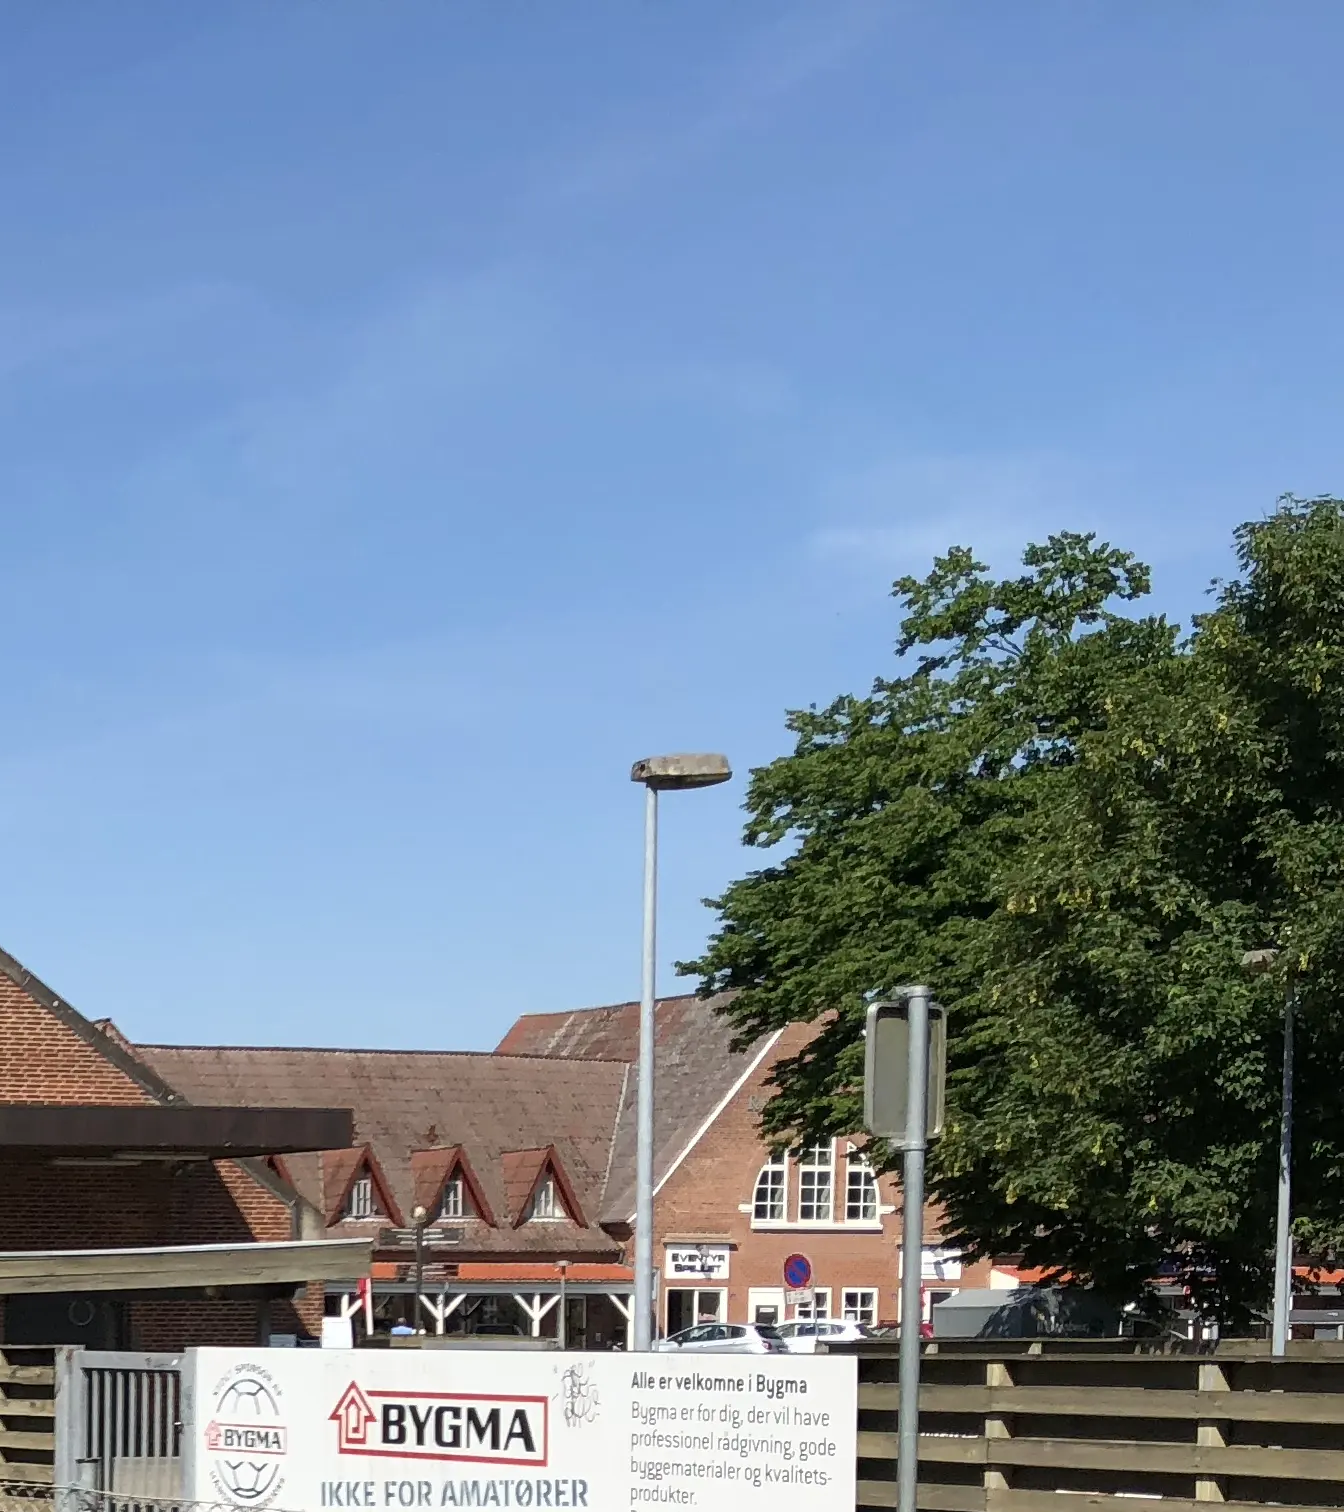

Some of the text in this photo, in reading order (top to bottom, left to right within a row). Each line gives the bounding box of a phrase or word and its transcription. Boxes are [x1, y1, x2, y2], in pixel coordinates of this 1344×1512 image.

[631, 1371, 656, 1390] Alle
[658, 1376, 673, 1390] er
[676, 1372, 745, 1393] velkomne
[756, 1374, 808, 1400] Bygma
[381, 1403, 537, 1453] BYGMA
[631, 1401, 830, 1429] Bygma er for dig, der vil have
[224, 1428, 282, 1450] BYGMA
[631, 1429, 837, 1462] professionel rådgivning, gode
[630, 1456, 833, 1488] byggematerialer og kvalitets-
[320, 1478, 590, 1508] IKKE FOR AMATØRER
[630, 1485, 698, 1506] produkter.
